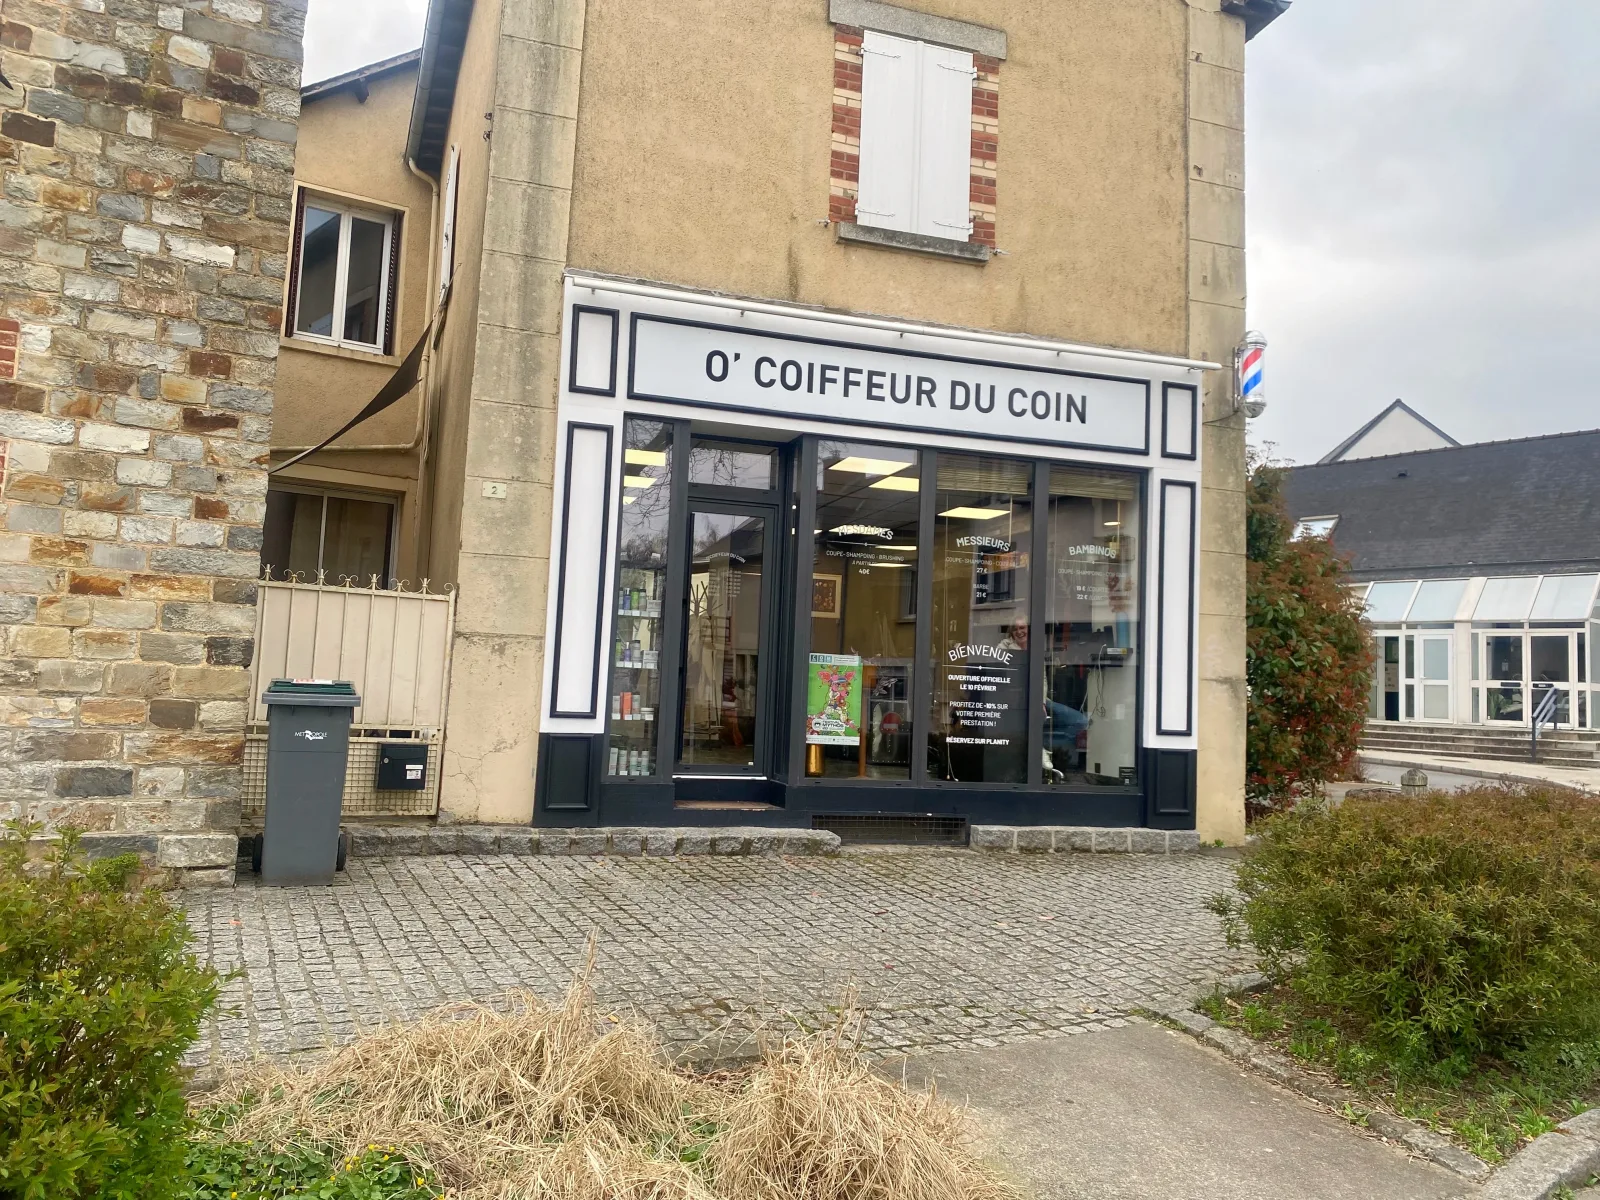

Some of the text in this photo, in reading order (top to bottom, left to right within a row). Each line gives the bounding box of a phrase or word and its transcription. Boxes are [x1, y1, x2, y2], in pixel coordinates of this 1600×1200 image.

[705, 349, 1088, 424] O' COIFFEUR DU COIN
[491, 486, 498, 494] 2
[838, 525, 894, 540] MESDAMES
[956, 536, 1010, 552] MESSIEURS
[1069, 544, 1116, 559] BAMBINOS
[948, 644, 1014, 665] BIENVENUE
